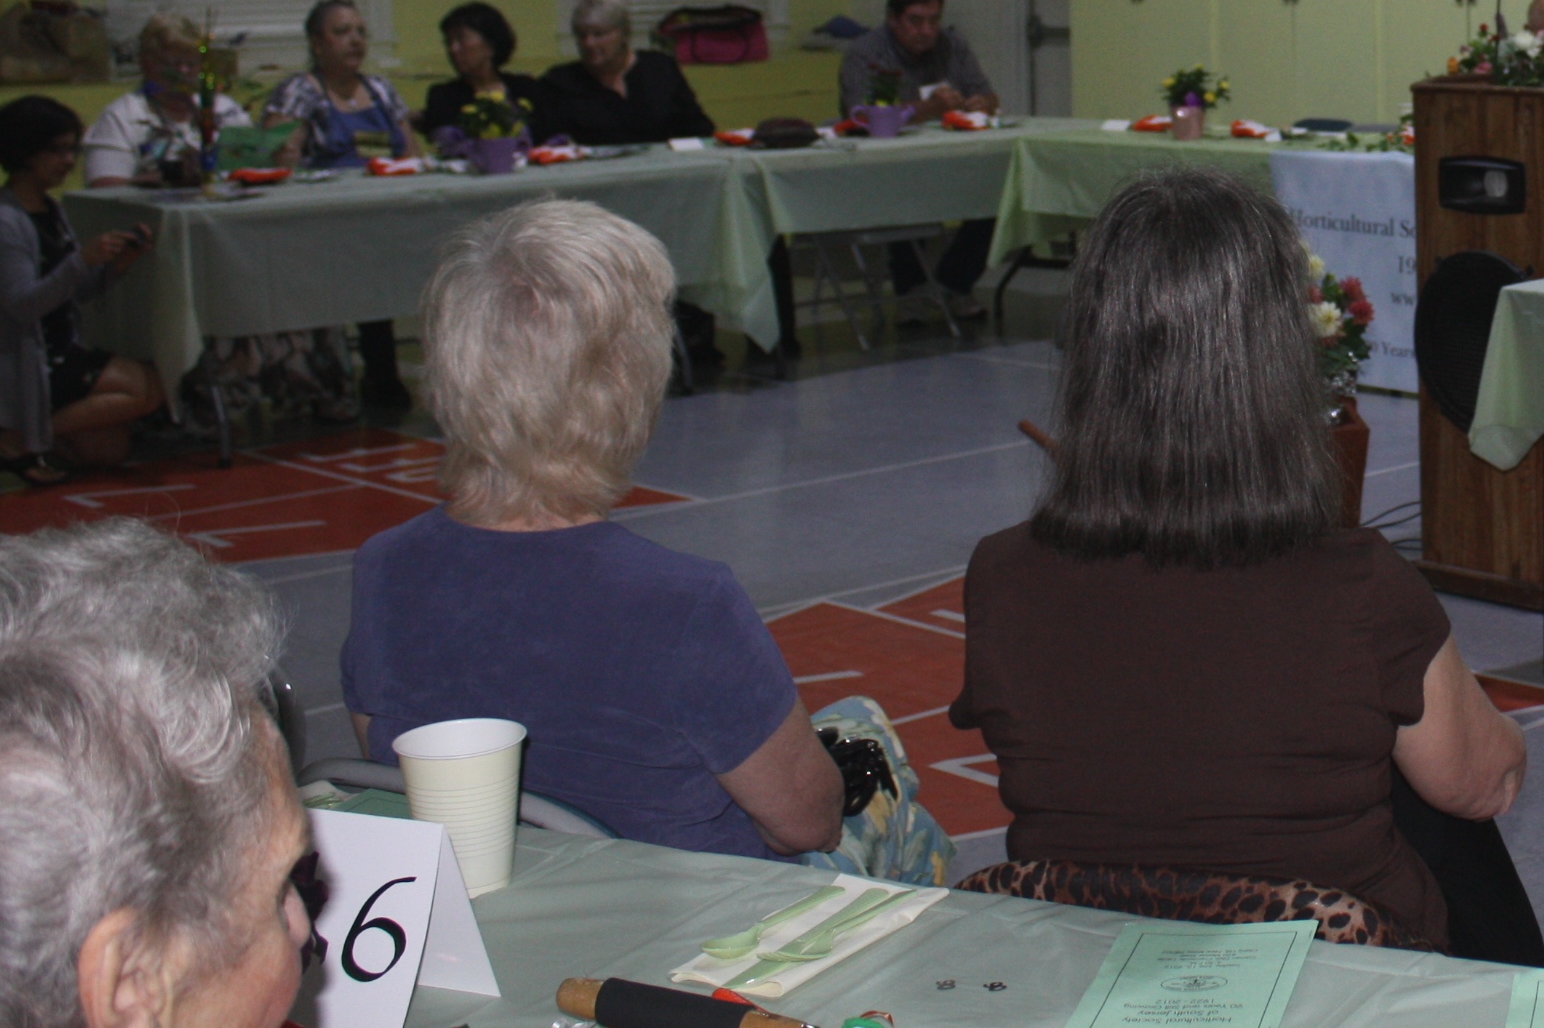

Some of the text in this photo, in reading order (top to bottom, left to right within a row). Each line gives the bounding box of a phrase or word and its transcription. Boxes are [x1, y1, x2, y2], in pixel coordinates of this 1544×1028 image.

[1398, 255, 1415, 274] 19
[341, 876, 417, 983] 6
[1121, 1016, 1232, 1024] Horticultural Society
